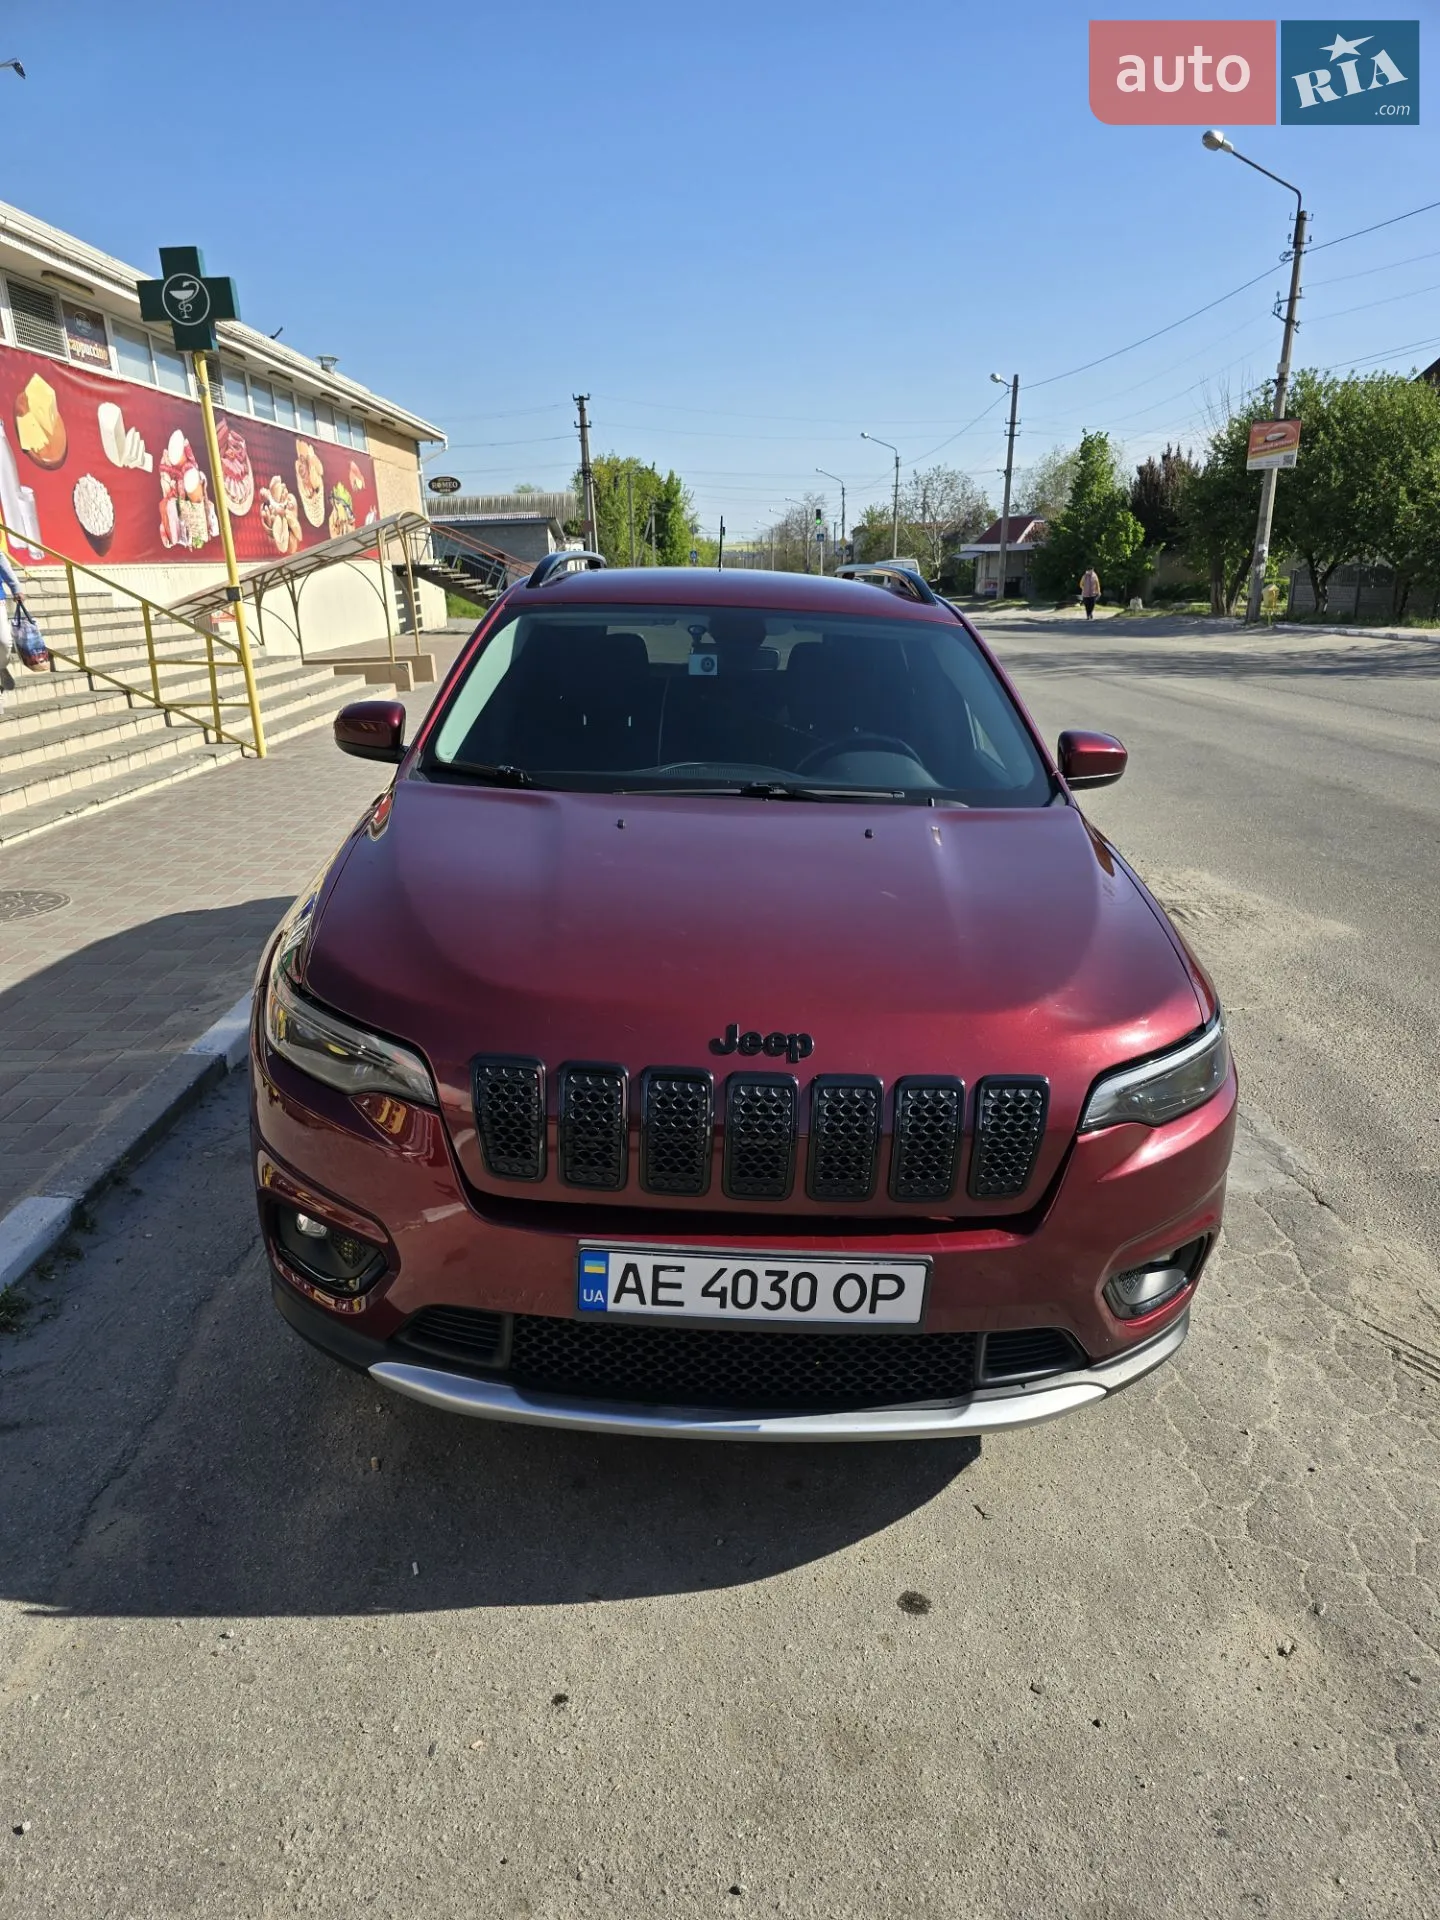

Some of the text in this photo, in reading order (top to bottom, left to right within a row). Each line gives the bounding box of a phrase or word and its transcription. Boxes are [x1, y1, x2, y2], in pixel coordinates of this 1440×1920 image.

[708, 1024, 815, 1064] Jeep
[583, 1289, 605, 1303] UA
[612, 1262, 906, 1314] AE 4030 OP
